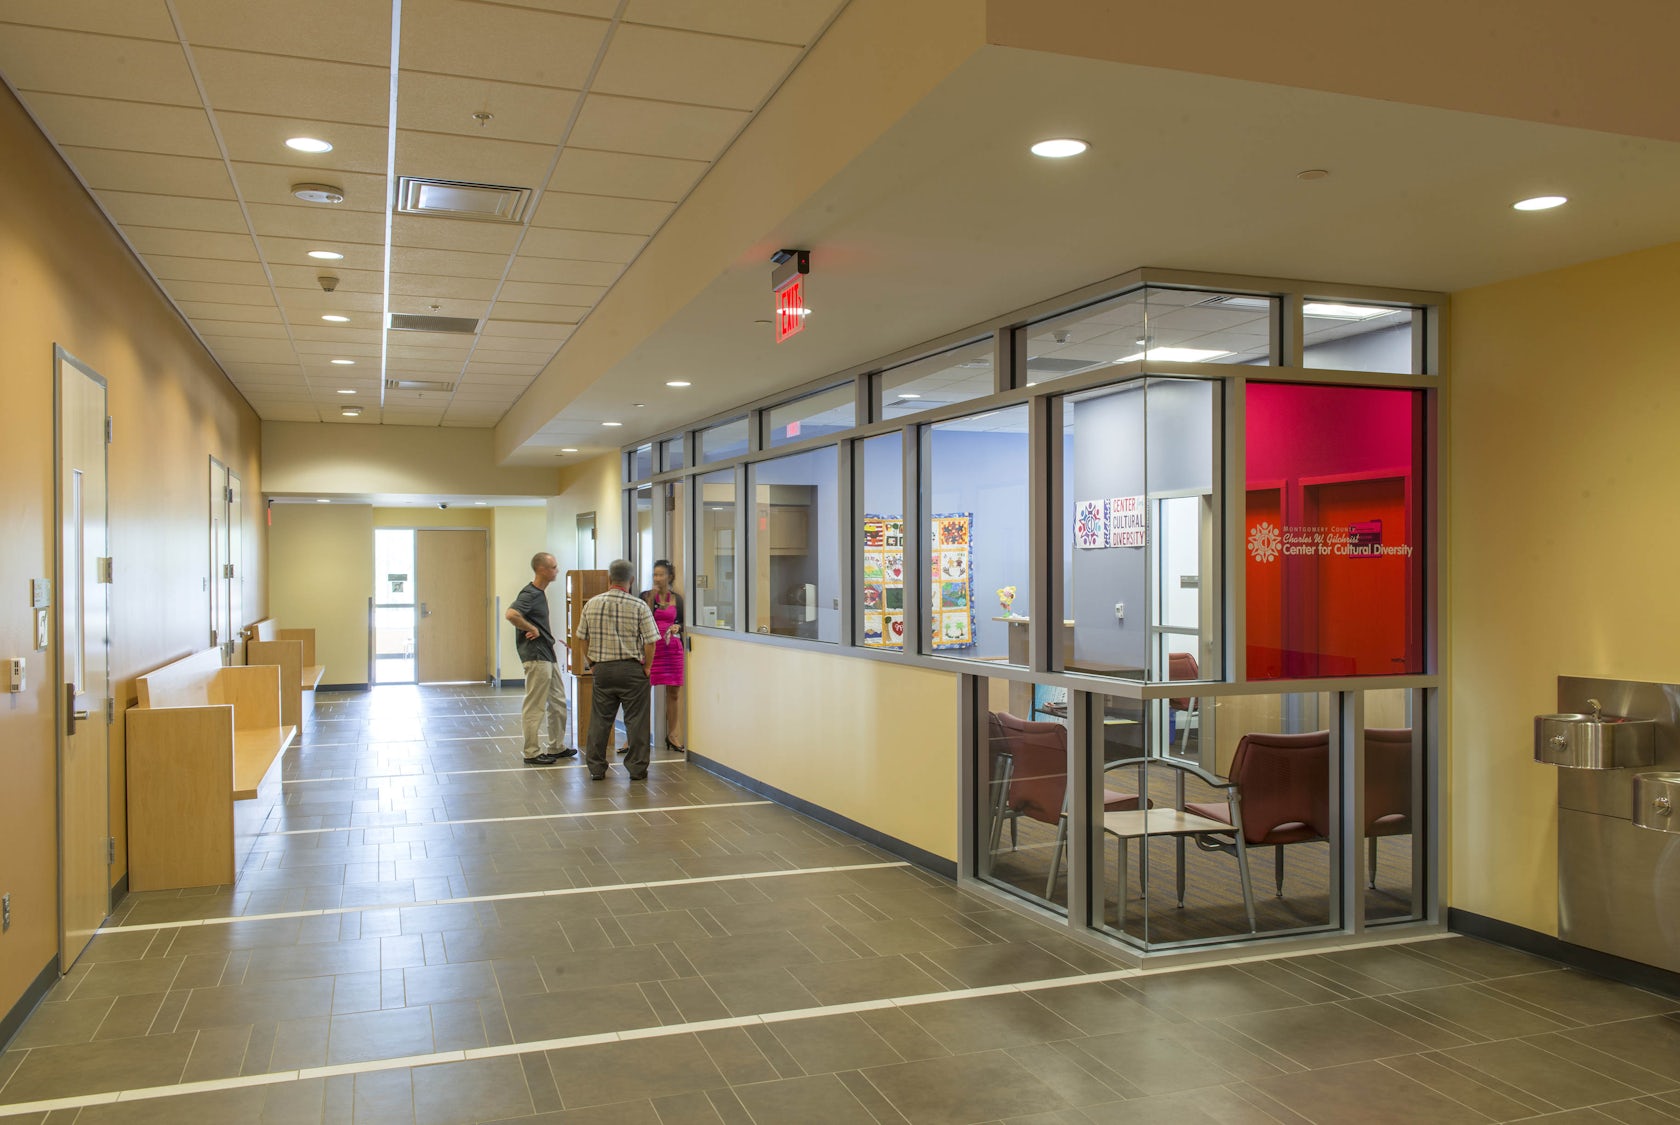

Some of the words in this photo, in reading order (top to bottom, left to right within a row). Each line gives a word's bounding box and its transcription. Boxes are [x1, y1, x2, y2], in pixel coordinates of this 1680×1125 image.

[781, 283, 799, 335] EXIT
[1113, 498, 1135, 512] CENTER
[1113, 514, 1145, 529] CULTURAL
[1113, 531, 1145, 546] DIVERSITY
[1283, 533, 1312, 543] Charles
[1326, 533, 1359, 545] Gilchrist
[1283, 544, 1316, 555] Center
[1318, 543, 1332, 555] for
[1334, 543, 1371, 555] Cultural
[1373, 543, 1413, 558] Diversity
